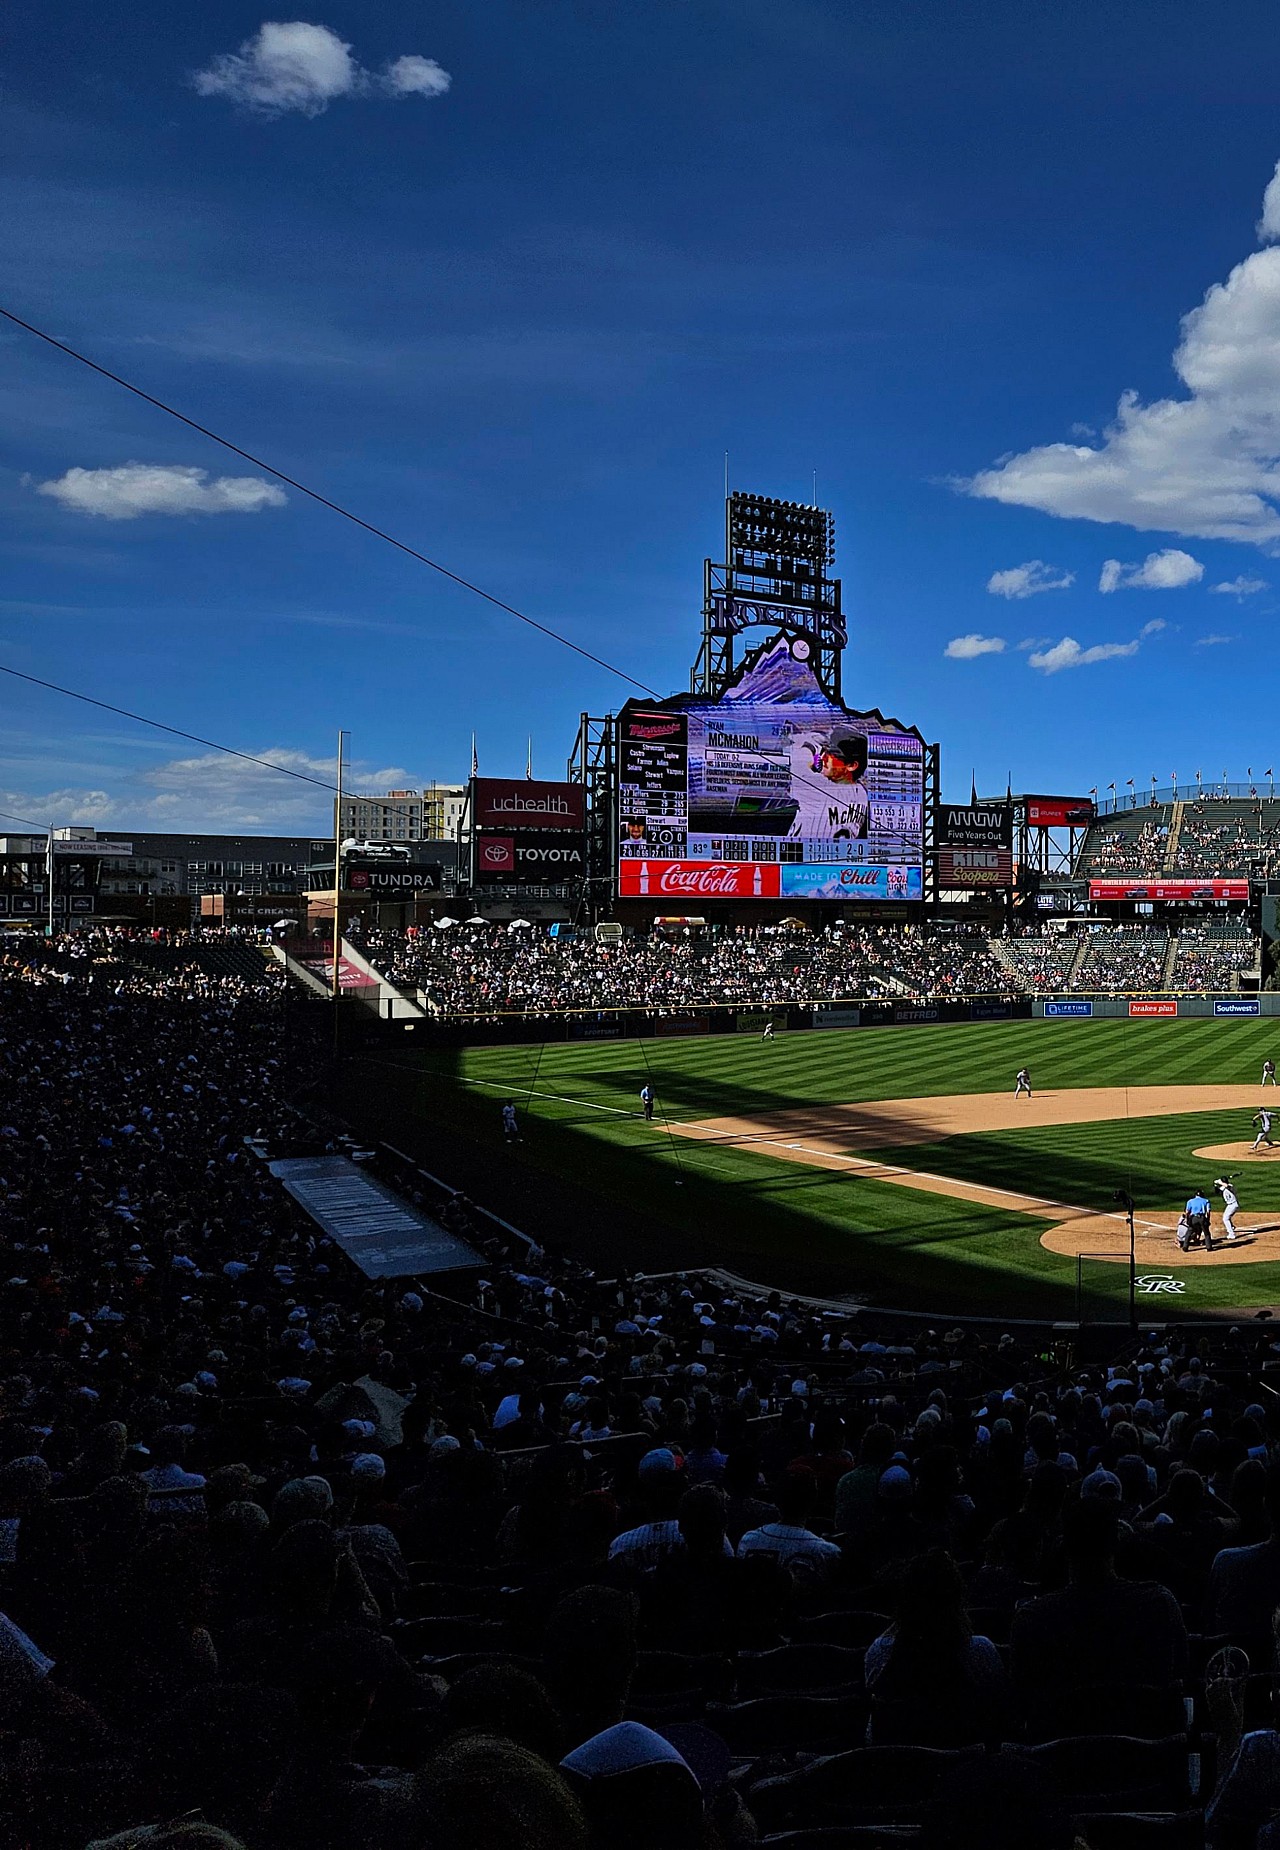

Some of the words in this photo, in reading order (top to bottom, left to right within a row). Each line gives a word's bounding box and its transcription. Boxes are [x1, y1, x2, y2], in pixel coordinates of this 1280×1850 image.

[711, 598, 848, 647] ROCKIES
[708, 721, 724, 730] RYAN
[708, 732, 759, 749] MCMAHON
[493, 792, 568, 814] uchealth
[947, 831, 964, 839] Five
[965, 831, 986, 840] Years
[987, 831, 1002, 840] Out
[516, 848, 581, 862] TOYOTA
[847, 844, 863, 855] 2-0
[952, 851, 998, 867] KING
[369, 874, 434, 886] TUNDRA
[794, 872, 822, 880] MADE
[839, 869, 879, 885] Chill
[952, 867, 999, 885] Soopers
[896, 1009, 938, 1020] BETFRED
[1132, 1004, 1157, 1012] brakes
[1158, 1005, 1173, 1013] plus
[1216, 1004, 1252, 1012] Southwest
